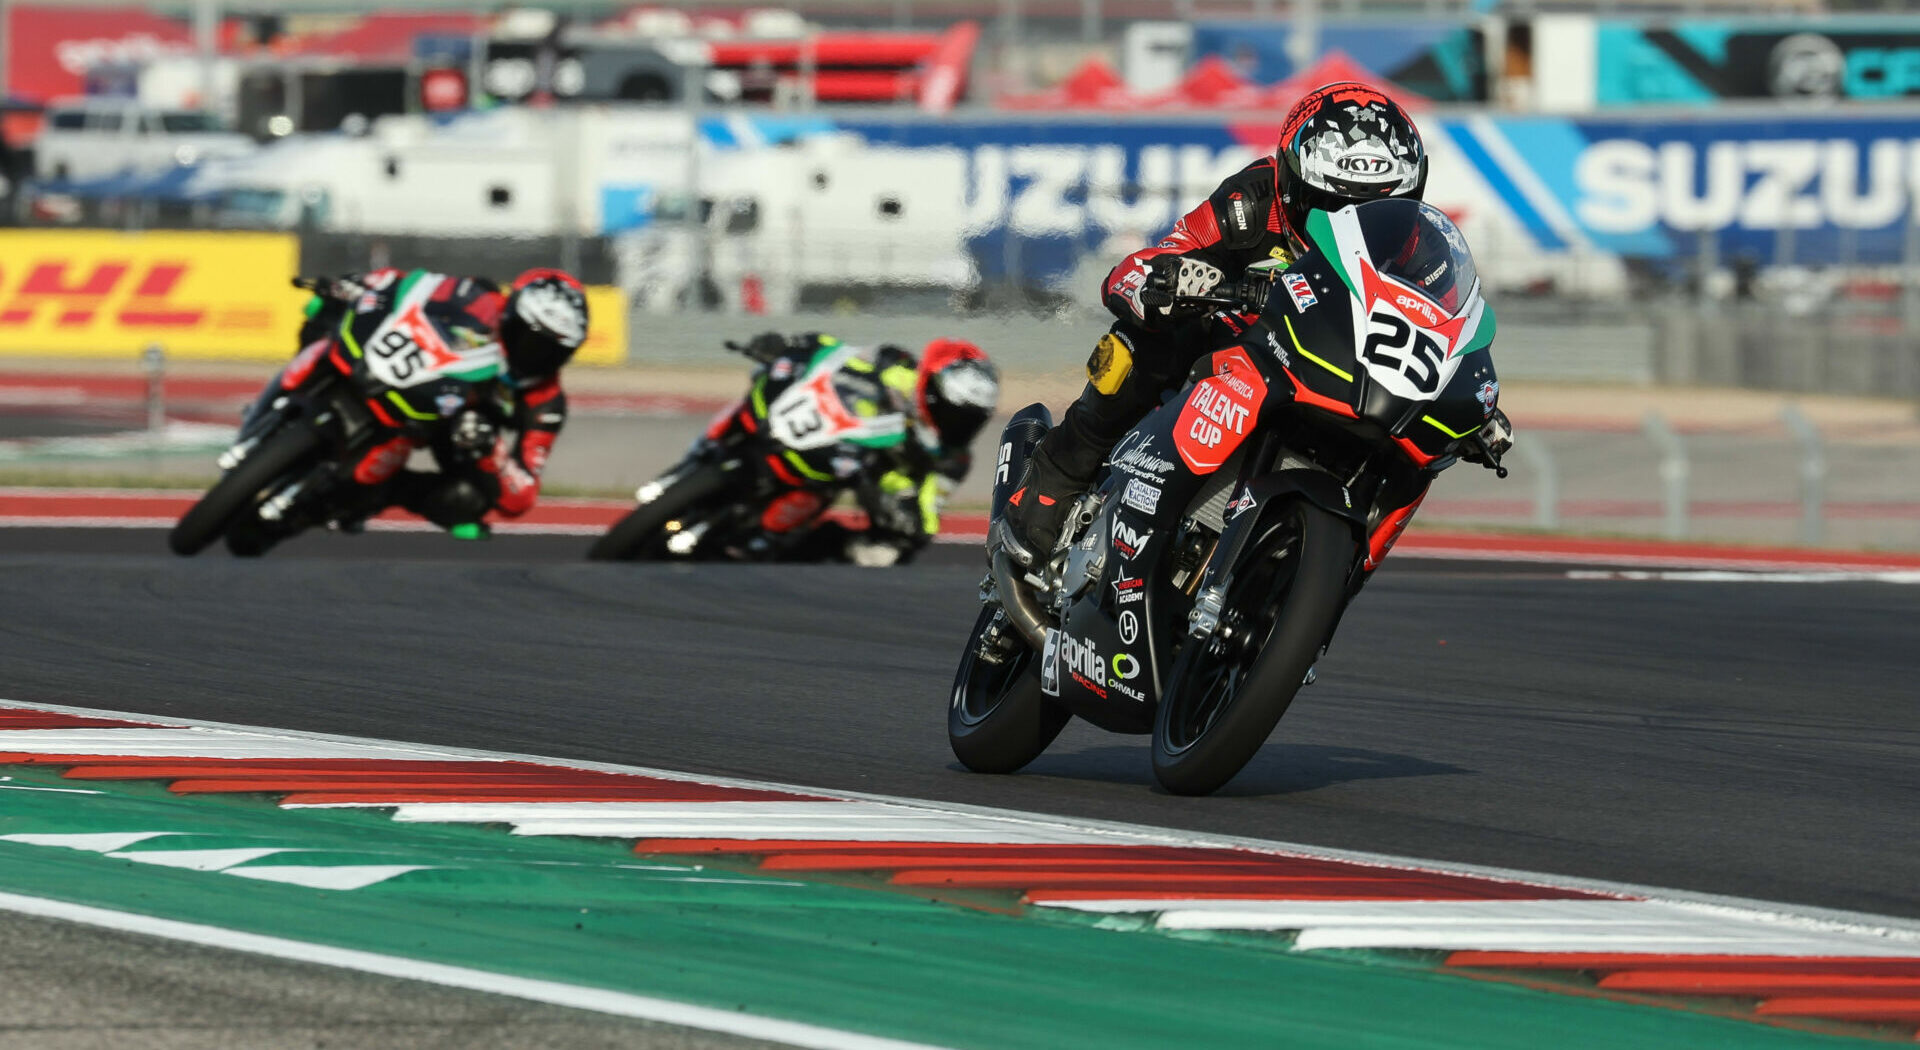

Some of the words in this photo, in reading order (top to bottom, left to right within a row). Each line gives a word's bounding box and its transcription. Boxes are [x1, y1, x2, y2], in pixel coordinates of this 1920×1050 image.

[1341, 158, 1388, 172] KYT
[1574, 138, 1920, 233] SUZU
[1233, 200, 1248, 231] BISON
[1424, 260, 1449, 287] BISON
[0, 262, 204, 326] HL
[1395, 293, 1438, 326] aprilia
[371, 330, 425, 381] 95
[1362, 311, 1445, 394] 25
[1227, 374, 1254, 400] AMERICA
[780, 399, 823, 438] 13
[1191, 381, 1250, 435] TALENT
[1189, 416, 1222, 448] CUP
[996, 441, 1013, 485] SC
[1119, 592, 1144, 605] ACADEMY
[1061, 631, 1106, 687] aprilia
[1072, 671, 1108, 700] RACING
[1108, 678, 1145, 702] OHVALE
